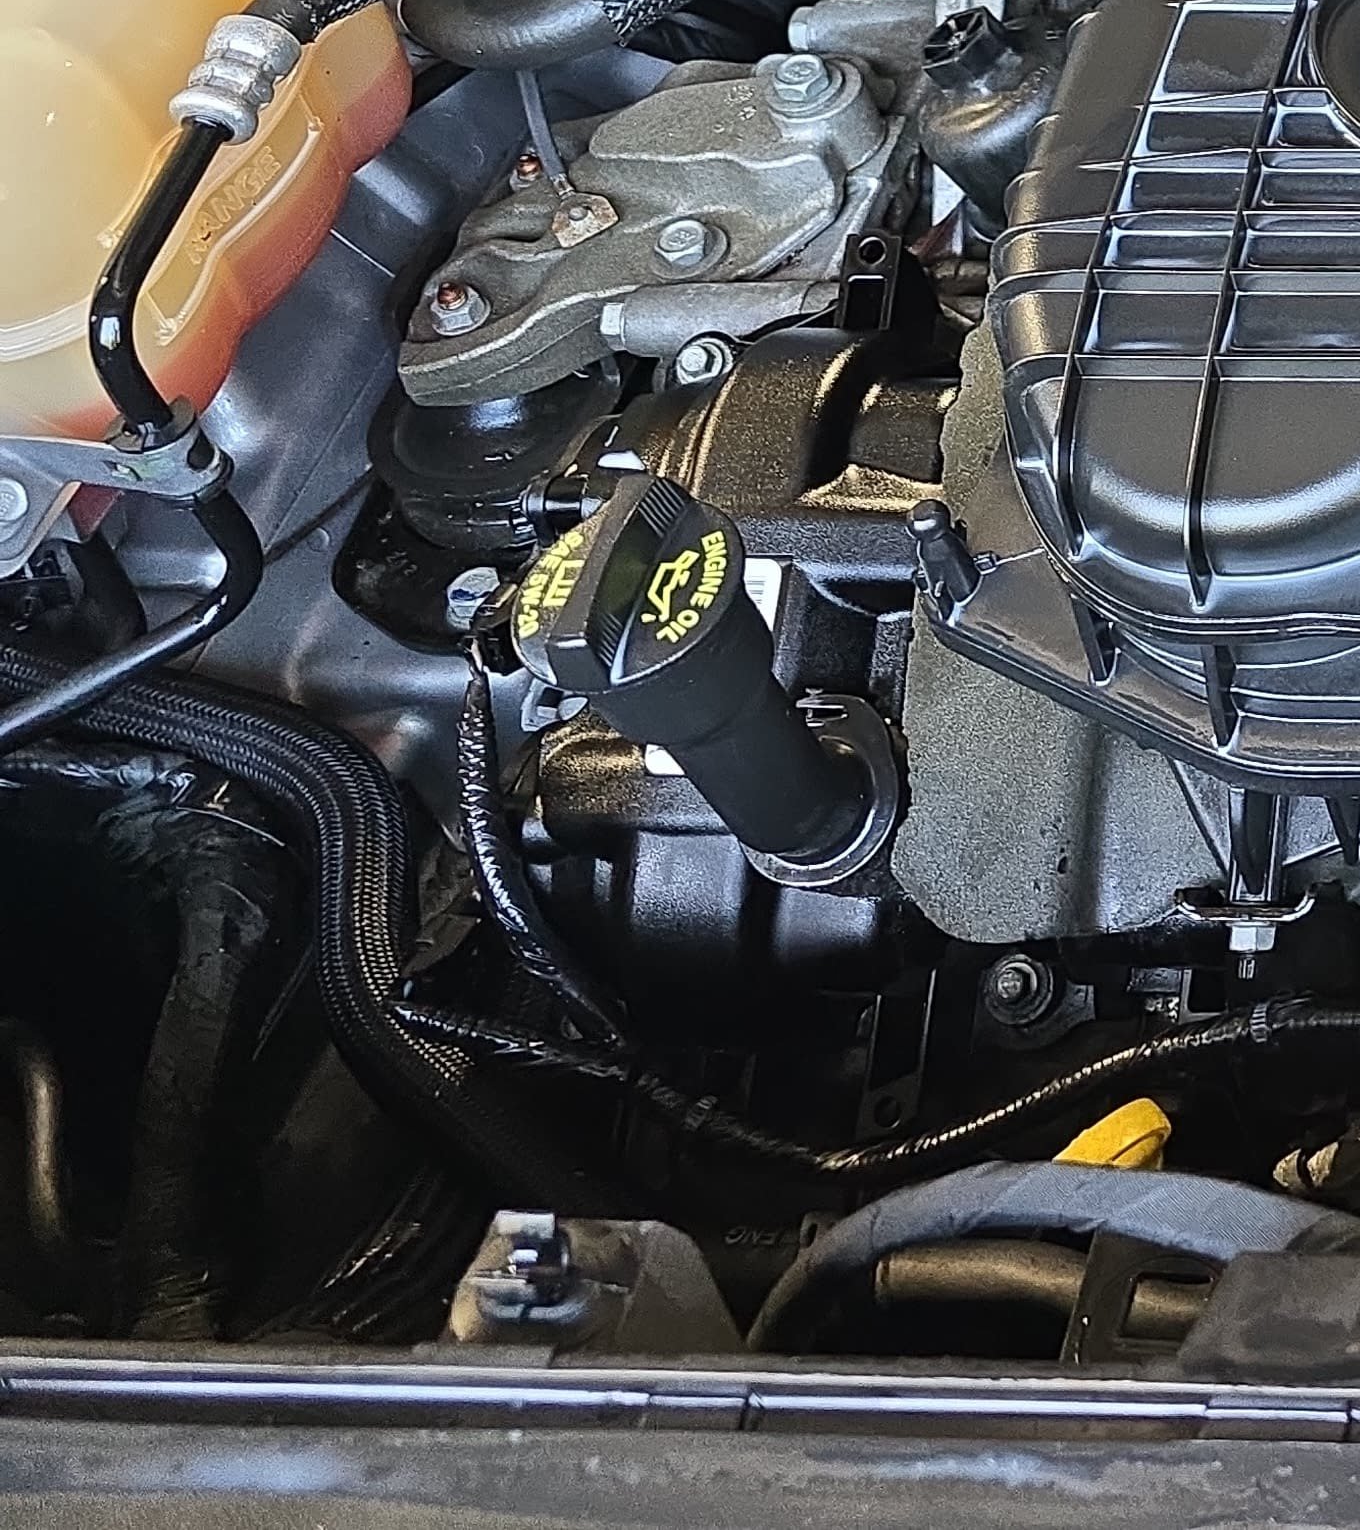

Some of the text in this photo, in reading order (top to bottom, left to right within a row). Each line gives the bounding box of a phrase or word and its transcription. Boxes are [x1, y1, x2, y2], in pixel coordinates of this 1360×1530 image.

[517, 572, 547, 640] 5W-20
[655, 530, 728, 644] ENGINE OIL
